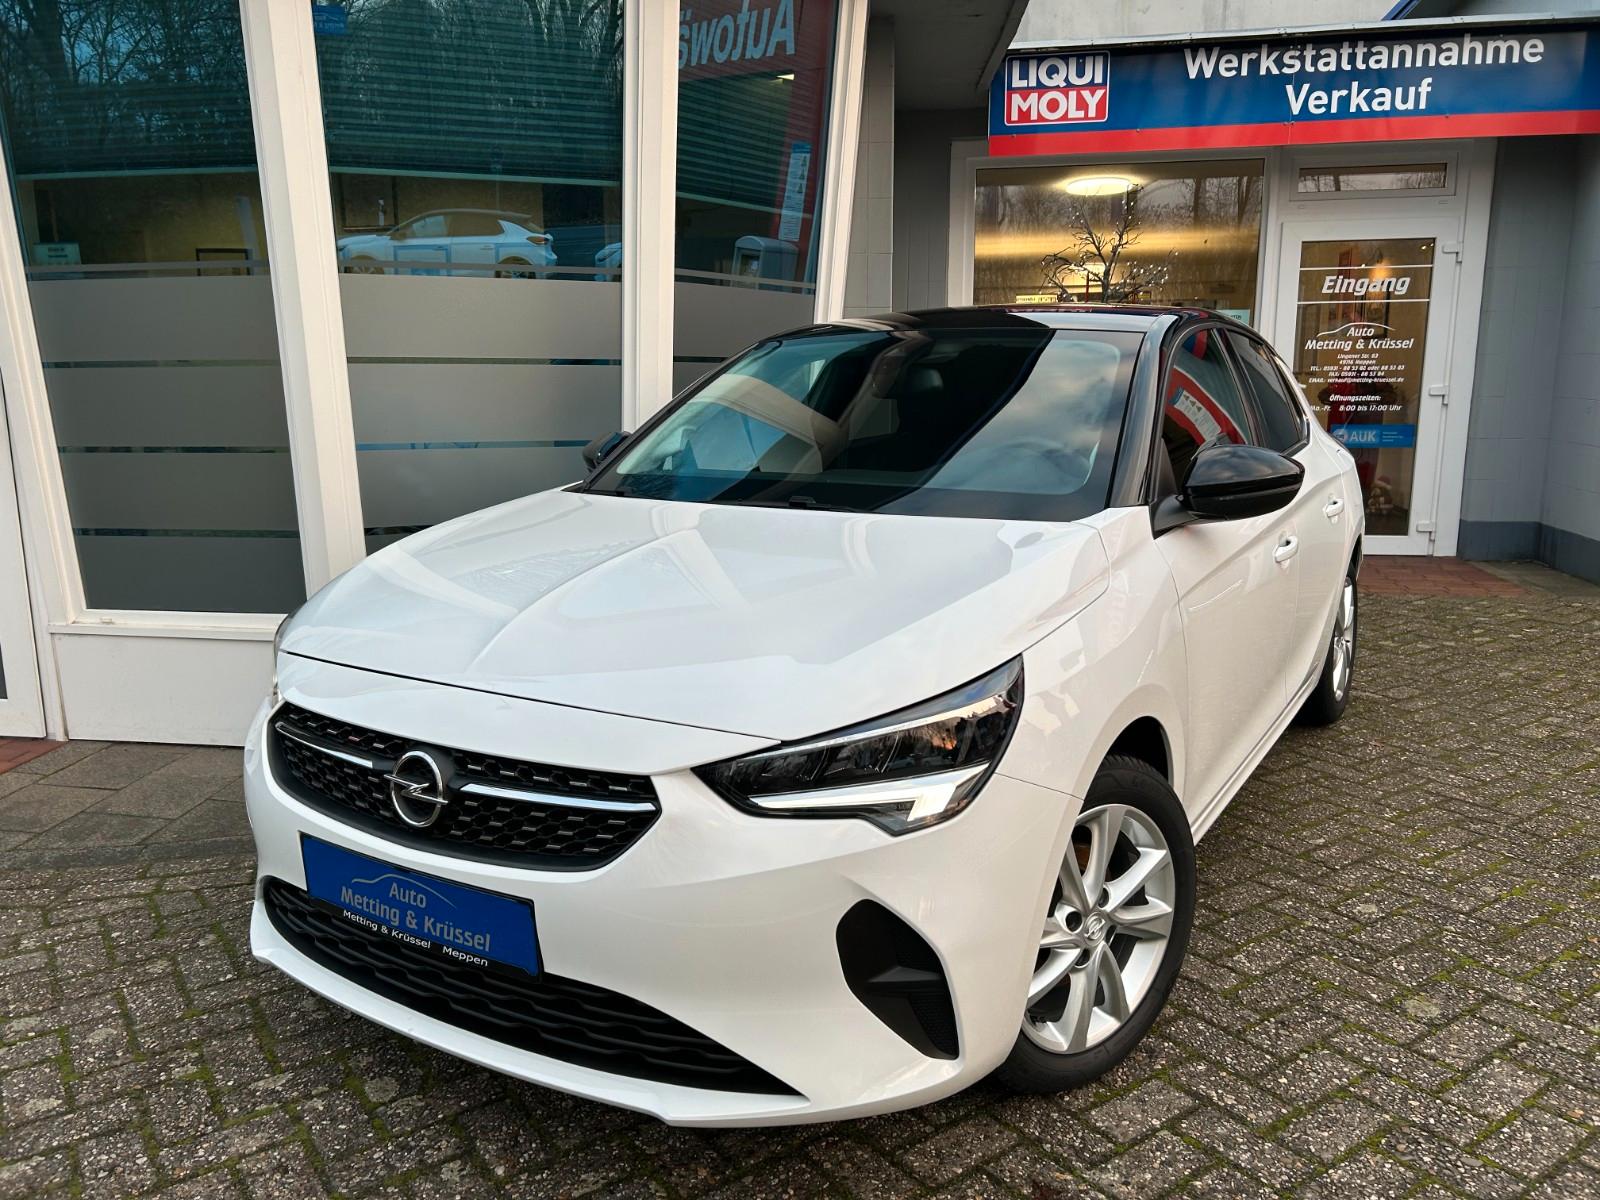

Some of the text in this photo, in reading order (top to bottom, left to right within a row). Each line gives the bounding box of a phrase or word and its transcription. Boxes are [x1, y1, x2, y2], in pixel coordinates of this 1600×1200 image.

[1011, 55, 1104, 88] LIQUI
[1184, 33, 1545, 80] Werkstattannahme
[1010, 89, 1106, 122] MOLY
[1285, 77, 1433, 116] Verkauf
[1321, 275, 1411, 296] Eingang
[1304, 338, 1415, 352] Metting & Krüssel
[1346, 327, 1375, 337] Auto
[1329, 394, 1382, 403] Öffnungszeiten:
[1350, 431, 1377, 442] AUK
[389, 882, 427, 909] Auto
[340, 885, 491, 952] Metting & Krüssel
[343, 909, 488, 967] Metting & Krüssel Meppen
